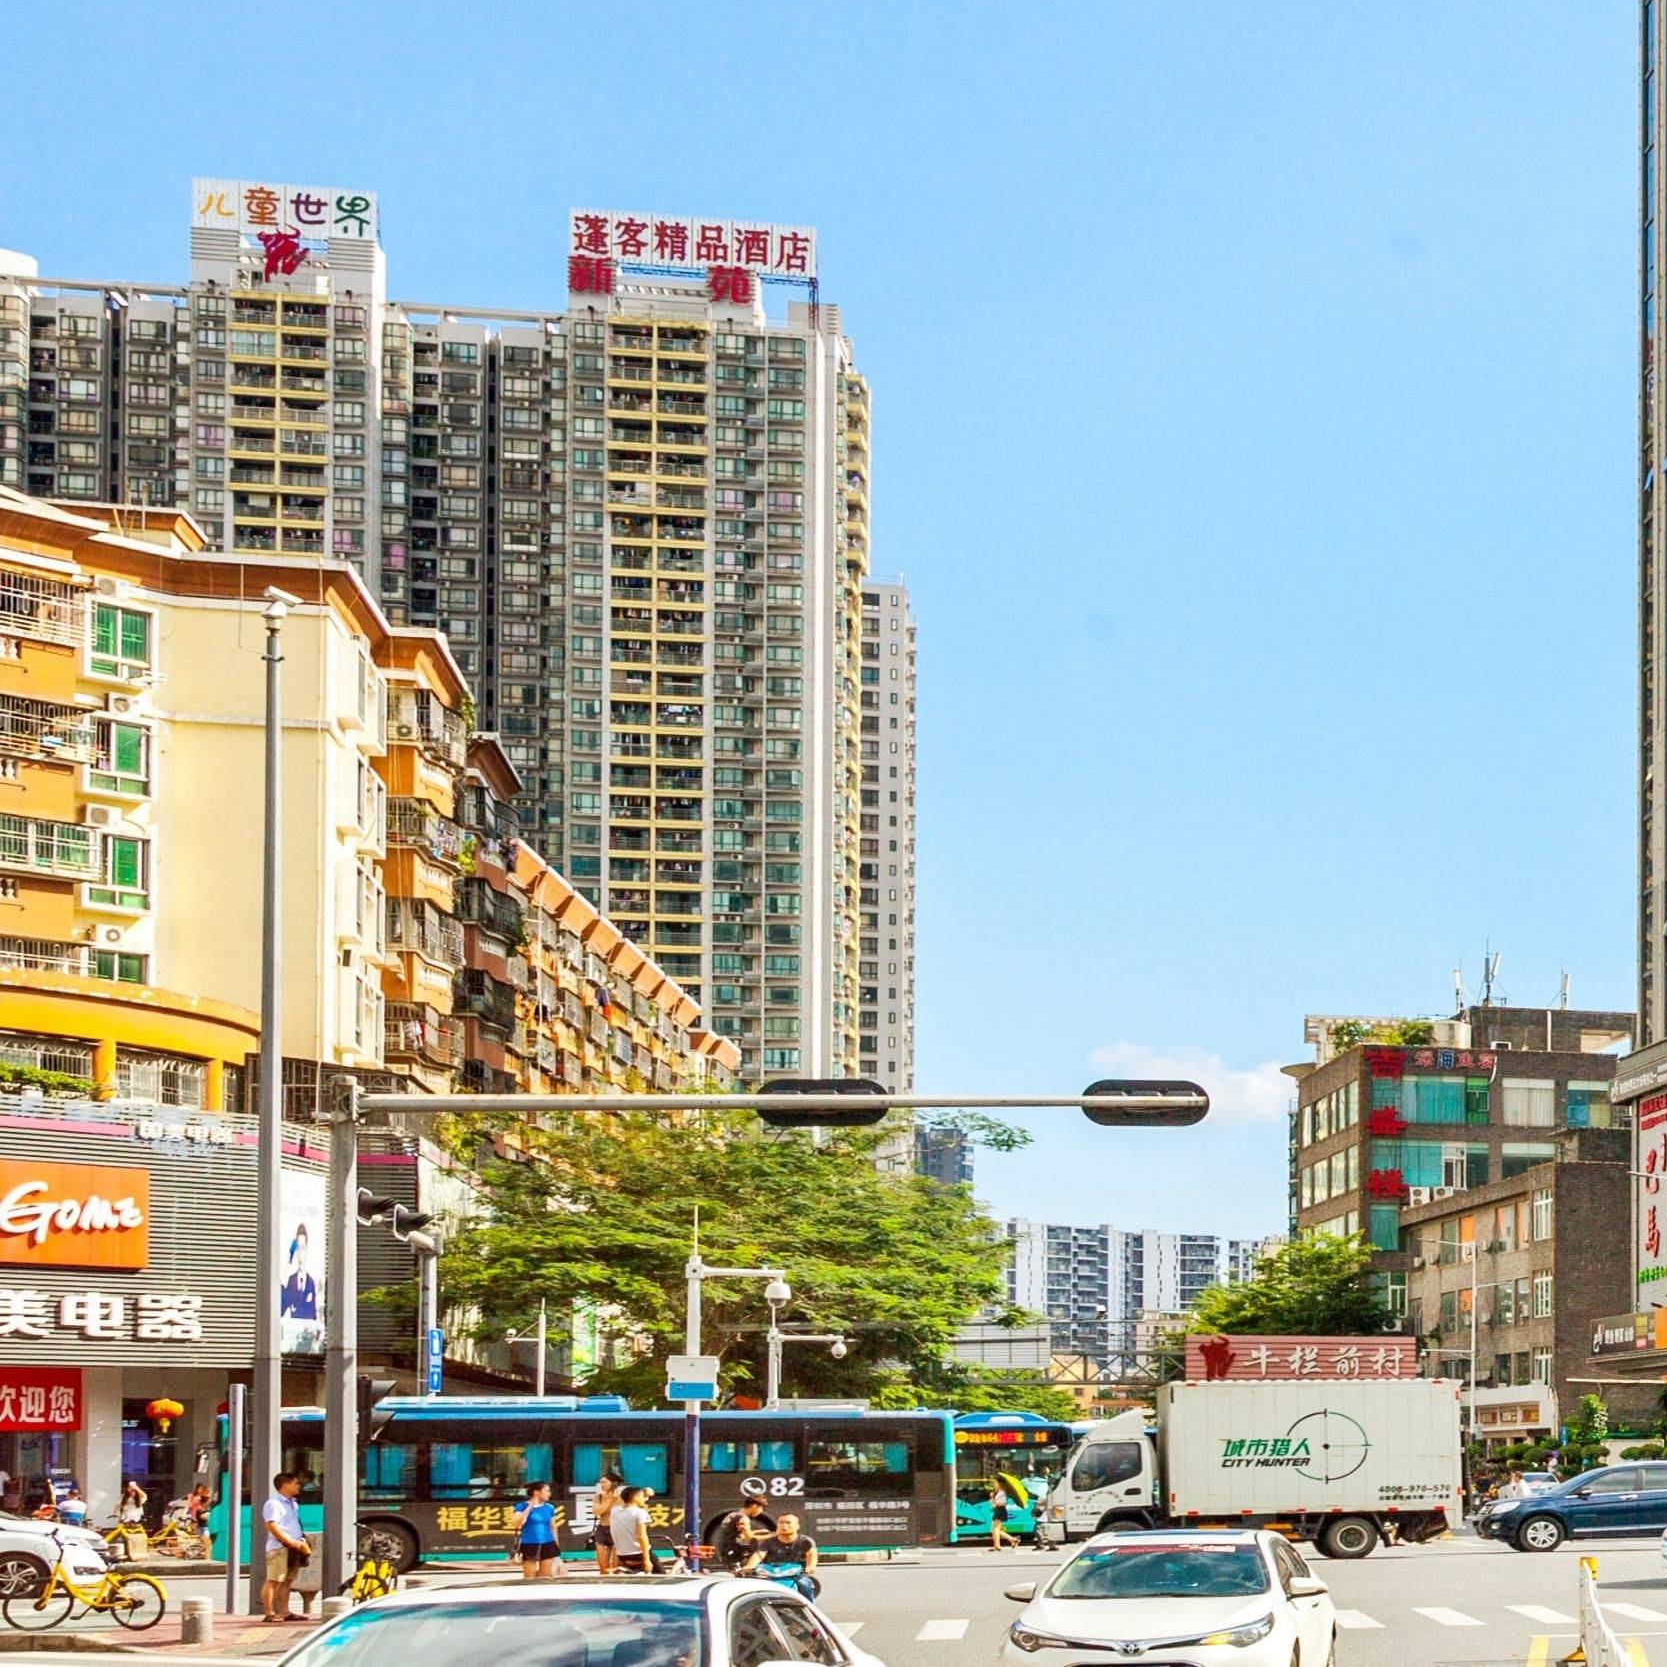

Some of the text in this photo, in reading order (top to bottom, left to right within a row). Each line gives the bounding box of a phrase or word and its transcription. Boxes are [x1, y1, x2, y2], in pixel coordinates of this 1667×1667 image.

[200, 186, 370, 237] 儿童世界
[573, 214, 810, 272] 蓬客精品酒店
[0, 1289, 204, 1339] 美电器
[1243, 1344, 1406, 1376] 牛栏前村
[1221, 1437, 1311, 1457] 城市猎人
[1221, 1457, 1311, 1468] CITY HUNTER
[769, 1476, 805, 1497] 82
